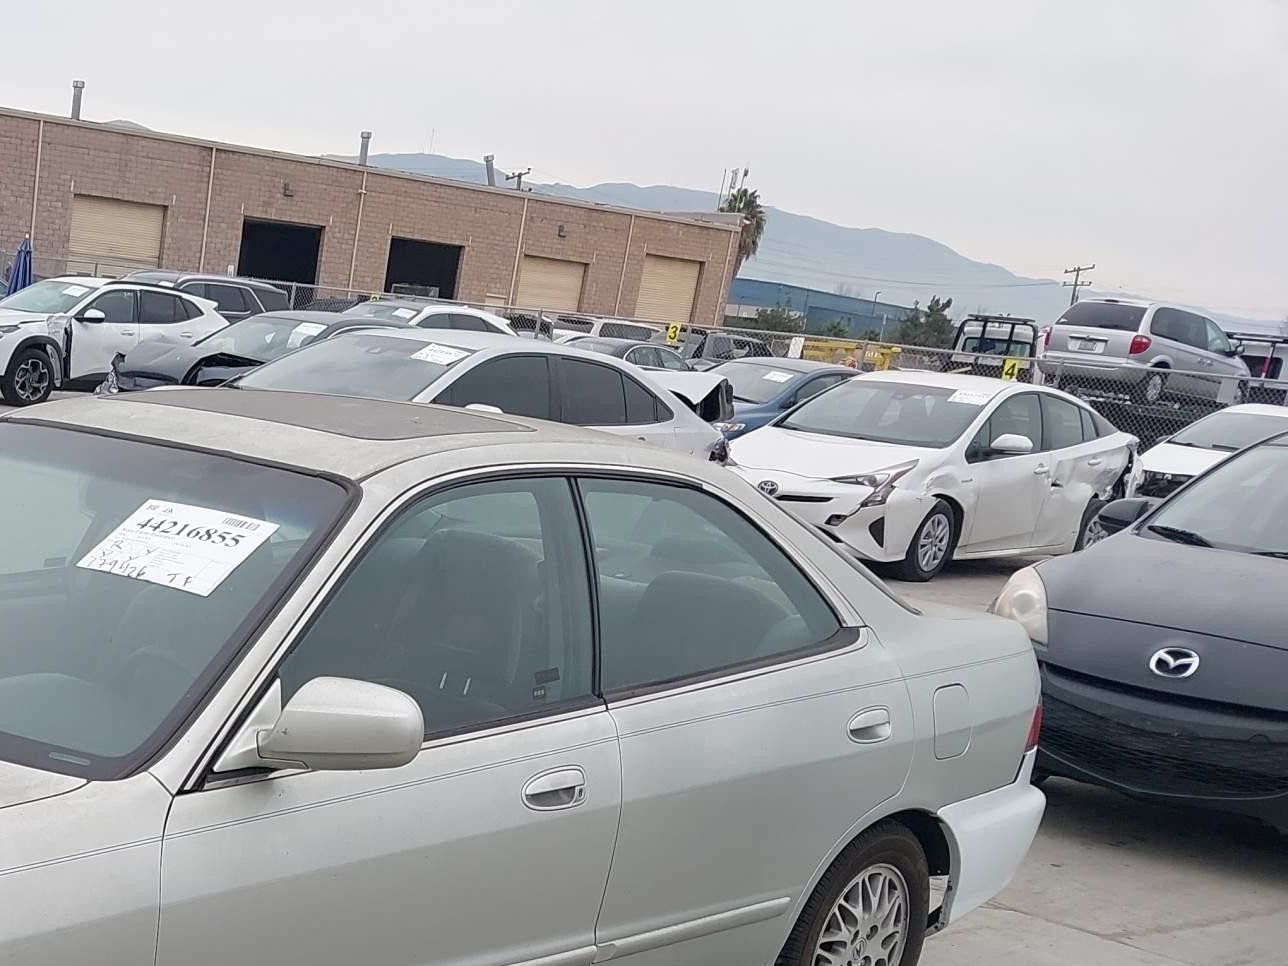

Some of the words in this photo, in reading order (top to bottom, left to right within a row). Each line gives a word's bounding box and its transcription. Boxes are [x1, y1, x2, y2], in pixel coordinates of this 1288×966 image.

[668, 325, 678, 340] 3
[1004, 362, 1017, 379] 4
[137, 516, 246, 548] 44216855
